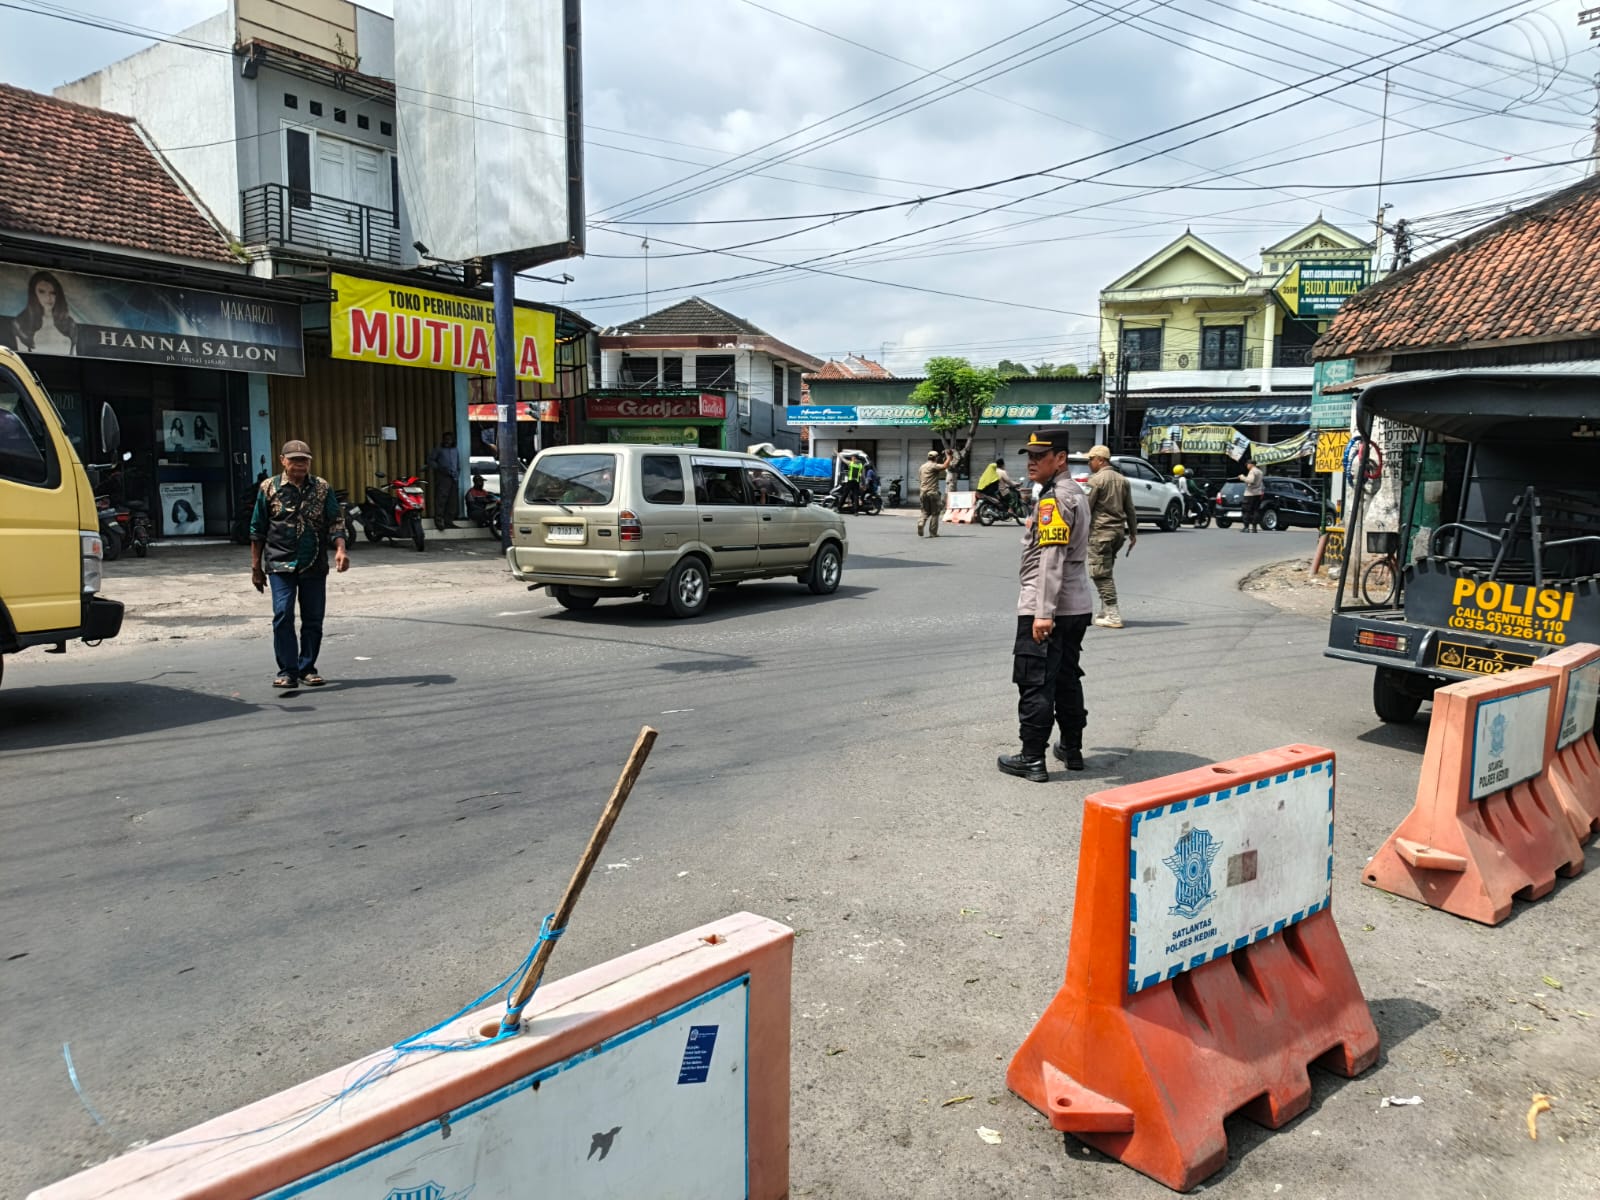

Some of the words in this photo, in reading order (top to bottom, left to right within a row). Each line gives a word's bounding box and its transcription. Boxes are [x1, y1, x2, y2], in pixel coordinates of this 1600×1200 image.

[1300, 280, 1327, 295] "BUDI
[1328, 280, 1362, 295] MULIA"
[388, 289, 421, 312] TOKO
[423, 296, 484, 322] PERHIASAN
[99, 330, 193, 353] HANNA
[202, 342, 278, 362] SALON
[350, 307, 541, 377] MUTIAA
[859, 406, 927, 418] WARUNG
[982, 406, 1007, 418] BU
[1007, 406, 1039, 418] BIN
[1378, 430, 1415, 441] MOTOR
[1452, 578, 1575, 622] POLISI
[1448, 615, 1567, 645] (0354)326110
[1456, 606, 1484, 620] CALL
[1486, 611, 1533, 628] CENTRE
[1542, 620, 1564, 632] 110
[1495, 652, 1505, 660] X
[1165, 936, 1193, 956] POLRES
[1194, 928, 1218, 944] KEDIRI
[1172, 918, 1212, 940] SATLANTAS
